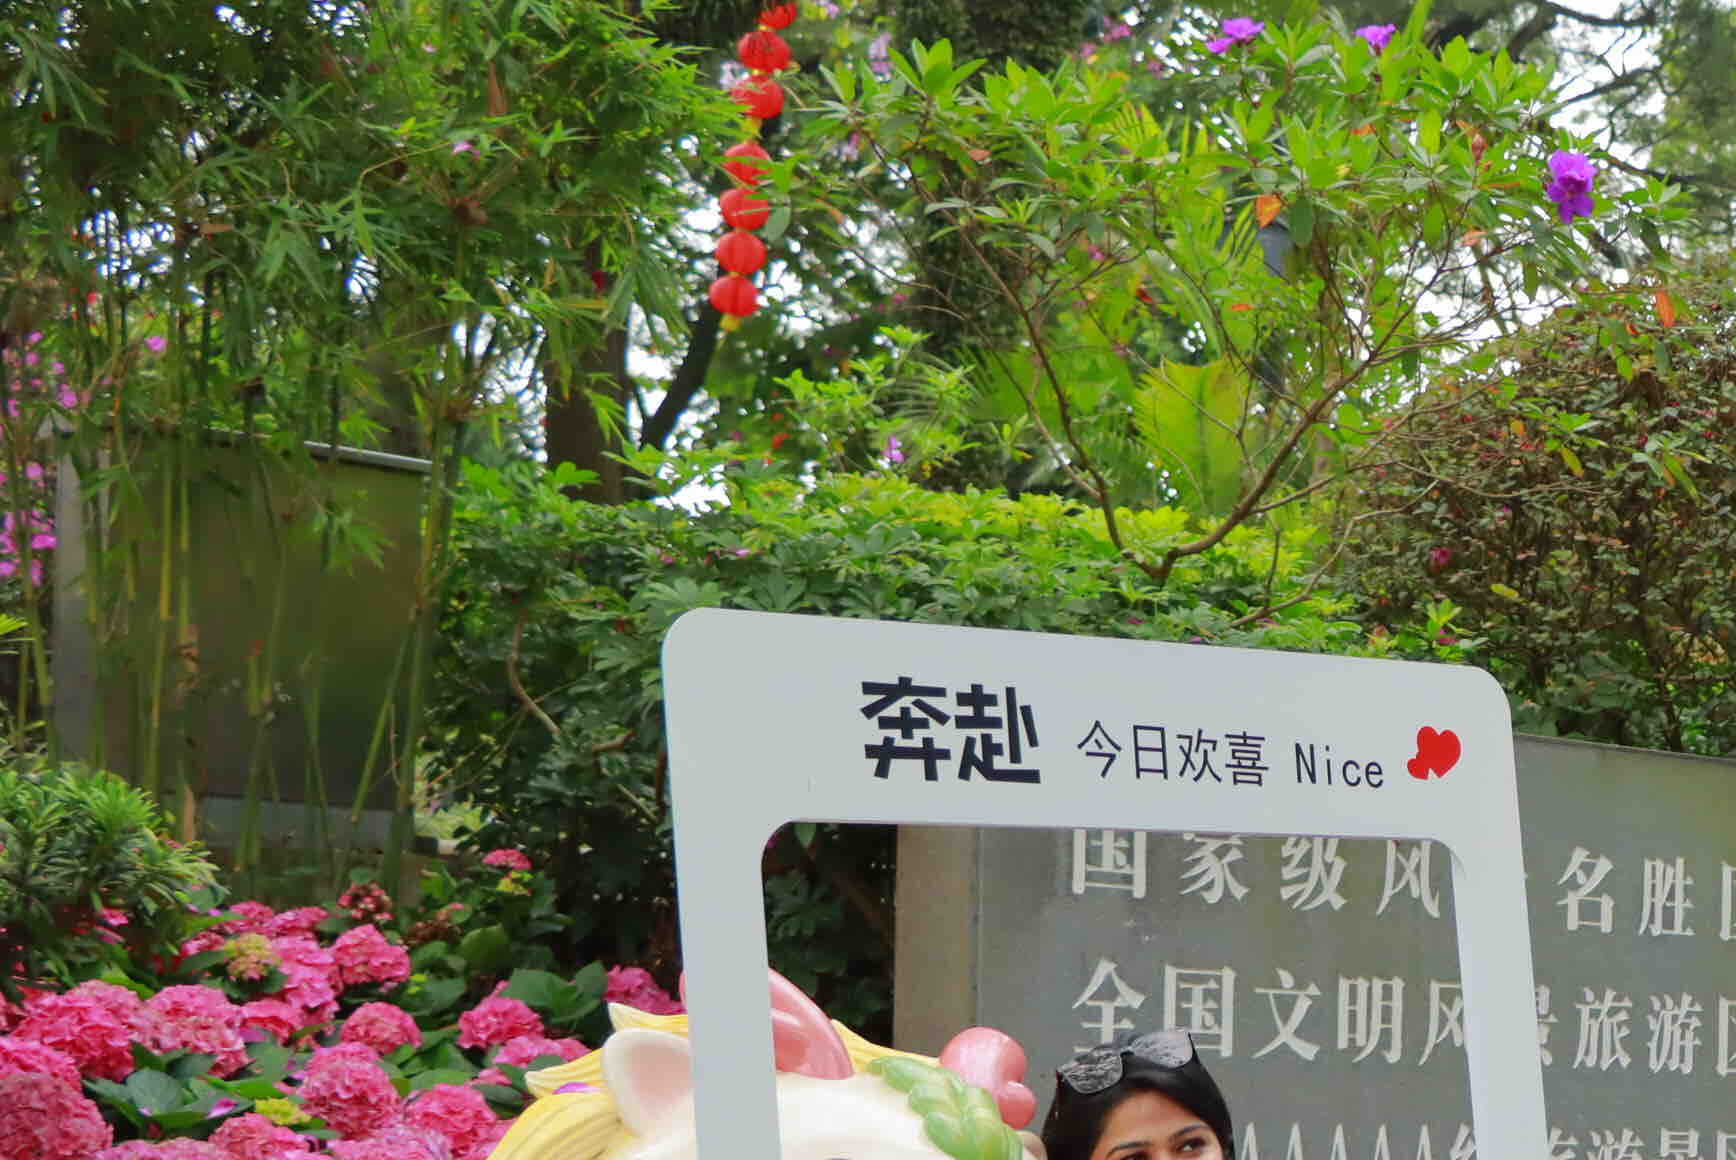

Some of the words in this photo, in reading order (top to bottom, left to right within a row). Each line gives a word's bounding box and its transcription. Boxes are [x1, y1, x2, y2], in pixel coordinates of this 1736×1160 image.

[859, 675, 1041, 785] 奔赴
[1076, 719, 1270, 787] 今日欢喜
[1294, 742, 1384, 789] Nice
